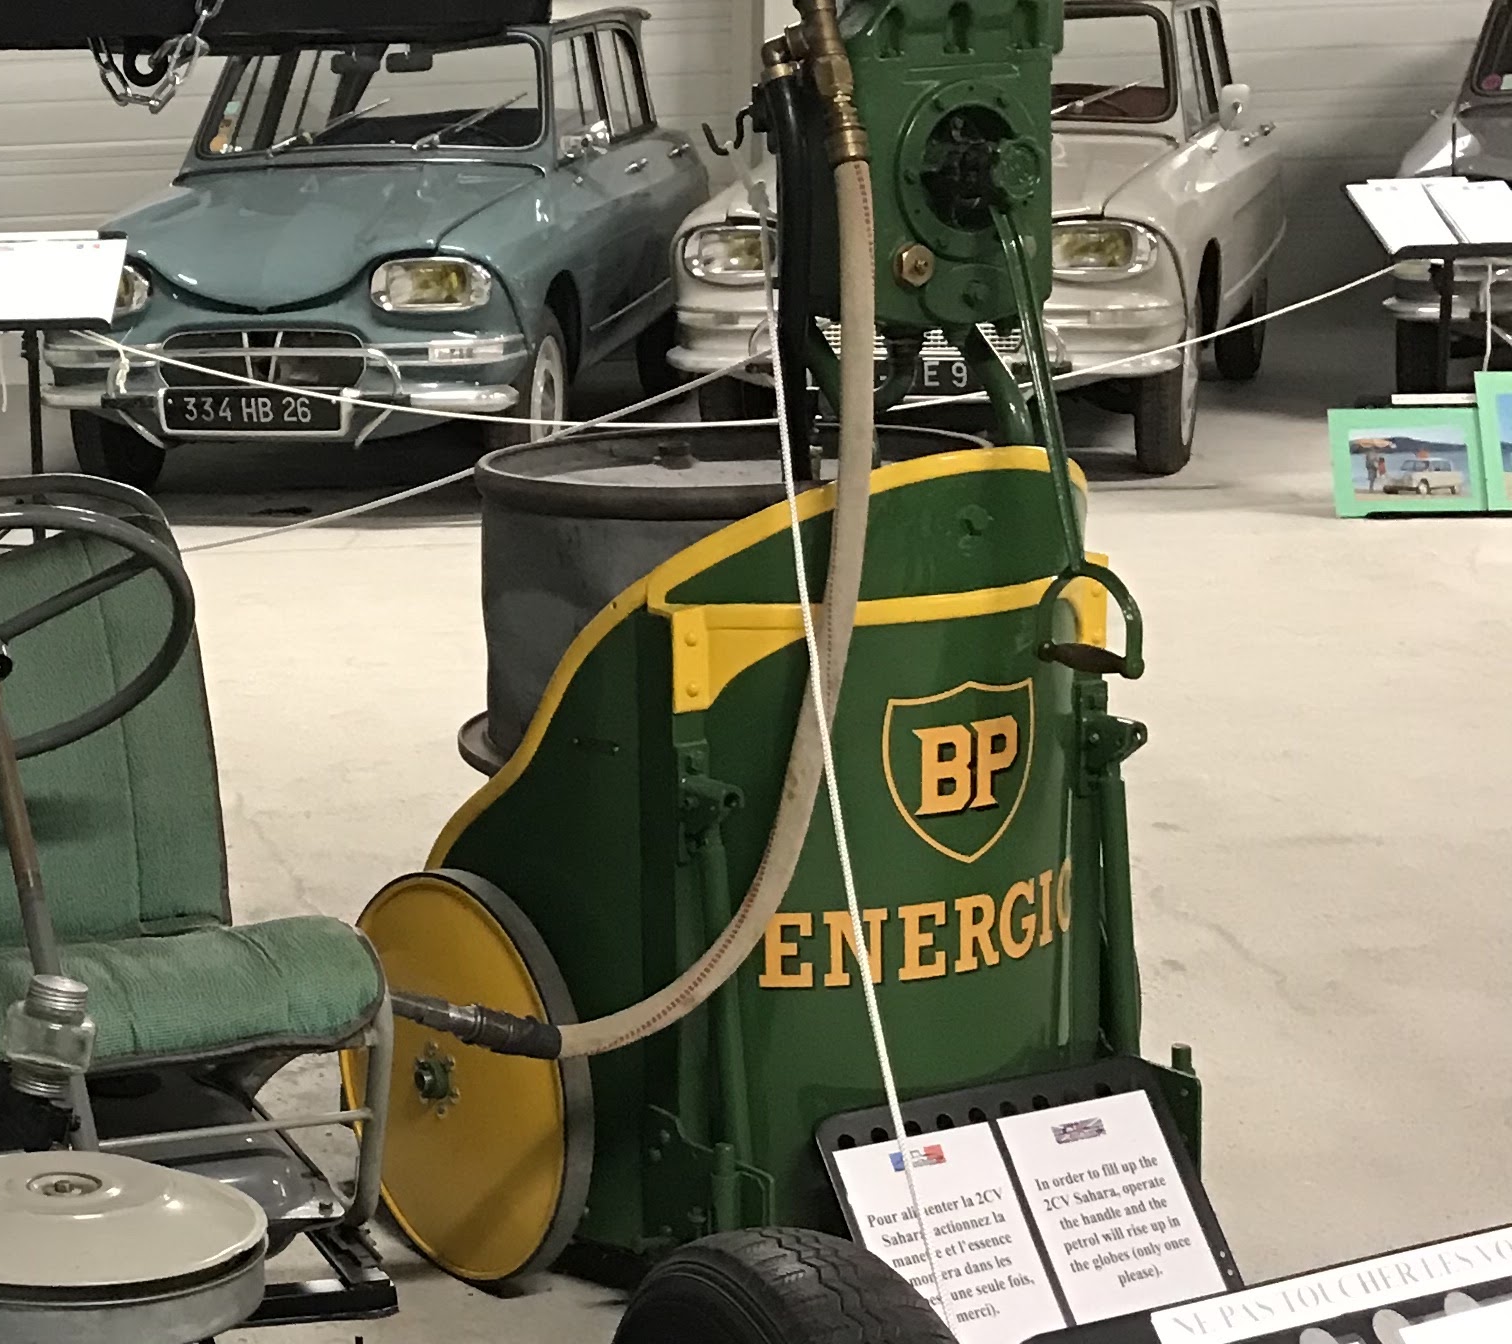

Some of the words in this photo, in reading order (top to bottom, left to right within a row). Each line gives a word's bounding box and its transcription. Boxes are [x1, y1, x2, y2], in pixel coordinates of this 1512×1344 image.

[183, 397, 232, 422] 334
[241, 397, 274, 423] HB
[282, 396, 312, 423] 26
[912, 714, 1019, 817] BP
[1034, 1178, 1050, 1191] In
[1052, 1172, 1085, 1188] order
[1087, 1169, 1100, 1181] to
[1101, 1162, 1120, 1177] fill
[1121, 1160, 1138, 1175] up
[1138, 1155, 1158, 1169] the
[867, 1212, 898, 1228] Pour
[900, 1199, 959, 1222] alienter
[960, 1195, 974, 1208] la
[975, 1186, 1003, 1205] 2CV
[1043, 1194, 1070, 1212] 2CV
[1073, 1187, 1121, 1205] Sahara,
[1122, 1175, 1167, 1197] operate
[933, 1215, 992, 1237] actionnez
[992, 1211, 1006, 1224] la
[1059, 1217, 1079, 1230] the
[1080, 1206, 1122, 1226] handle
[1125, 1201, 1147, 1217] and
[1148, 1196, 1168, 1210] the
[945, 1243, 957, 1256] et
[957, 1233, 1012, 1254] l'essence
[1063, 1233, 1100, 1256] petrol
[1101, 1227, 1125, 1242] will
[1126, 1223, 1149, 1238] rise
[1150, 1220, 1167, 1233] up
[1166, 1215, 1181, 1228] in
[909, 1267, 962, 1288] monera
[964, 1260, 993, 1275] dans
[994, 1255, 1012, 1268] les
[1069, 1259, 1090, 1273] the
[1092, 1251, 1131, 1271] globes
[1131, 1242, 1162, 1260] (only
[1164, 1236, 1192, 1251] once
[975, 1278, 1006, 1296] seule
[1007, 1272, 1035, 1288] fois,
[1117, 1264, 1163, 1288] please).
[1219, 1295, 1276, 1330] PAS
[1281, 1260, 1420, 1314] TOUCHER
[956, 1302, 1000, 1323] merci).
